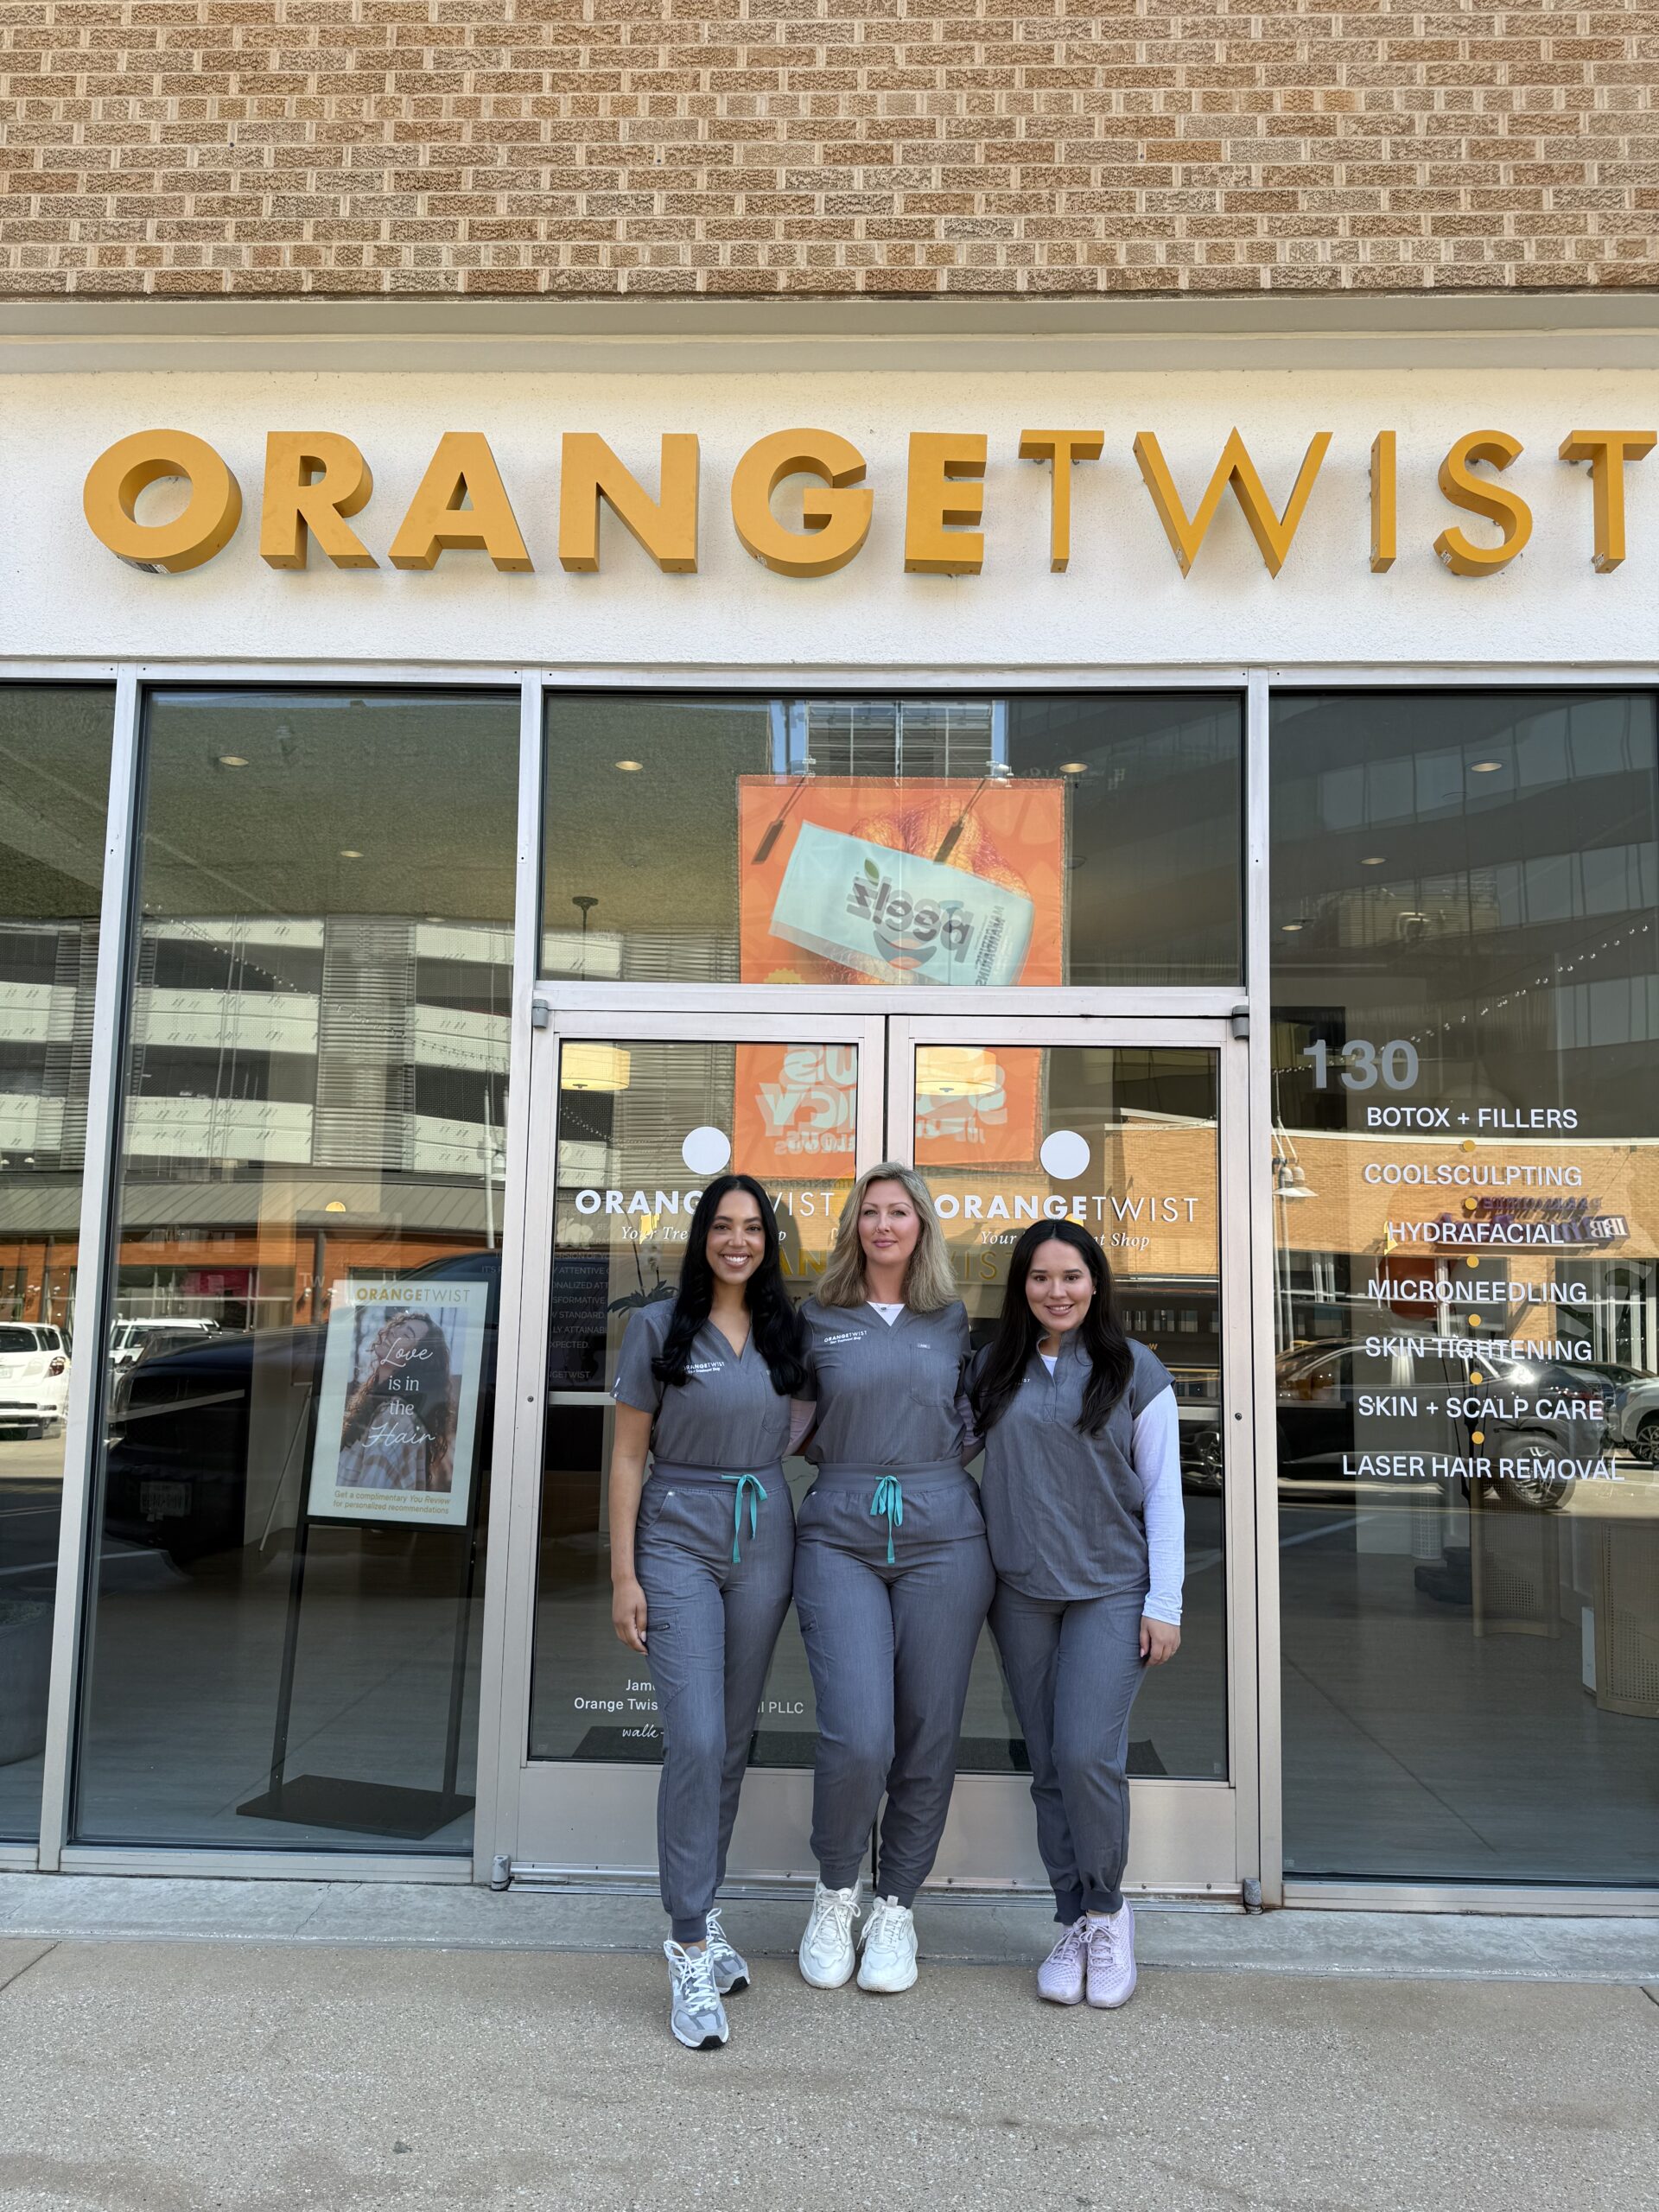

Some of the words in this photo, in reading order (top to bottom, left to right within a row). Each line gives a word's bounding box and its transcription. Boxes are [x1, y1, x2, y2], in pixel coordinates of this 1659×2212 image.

[83, 428, 1657, 579] ORANGETWIST
[1303, 1039, 1419, 1090] 130
[1367, 1107, 1450, 1128] BOTOX
[1457, 1112, 1470, 1125] +
[1478, 1108, 1578, 1128] FILLERS
[1364, 1163, 1582, 1186] COOLSCULPTING
[933, 1193, 1198, 1222] ORANGETWIST
[981, 1230, 1017, 1245] Your
[1111, 1233, 1150, 1250] Shop
[1388, 1222, 1565, 1244] HYDRAFACIAL
[356, 1287, 471, 1302] ORANGETWIST
[1368, 1279, 1587, 1303] MICRONEEDLING
[380, 1338, 434, 1367] Love
[1365, 1337, 1425, 1357] SKIN
[1432, 1338, 1592, 1361] TIGHTENING
[388, 1376, 401, 1390] is
[405, 1376, 419, 1391] in
[389, 1400, 415, 1415] the
[1358, 1395, 1418, 1417] SKIN
[1426, 1402, 1439, 1415] +
[1446, 1396, 1529, 1420] SCALP
[1535, 1398, 1604, 1421] CARE
[362, 1422, 436, 1448] Hair
[1342, 1454, 1426, 1477] LASER
[1432, 1456, 1491, 1478] HAIR
[1500, 1458, 1625, 1480] REMOVAL
[334, 1490, 347, 1498] Get
[355, 1491, 407, 1503] complimentary
[410, 1494, 423, 1503] You
[424, 1495, 451, 1504] Review
[344, 1500, 387, 1510] personalized
[388, 1504, 449, 1514] recommendations
[574, 1697, 624, 1713] Orange
[768, 1701, 804, 1714] PLLC
